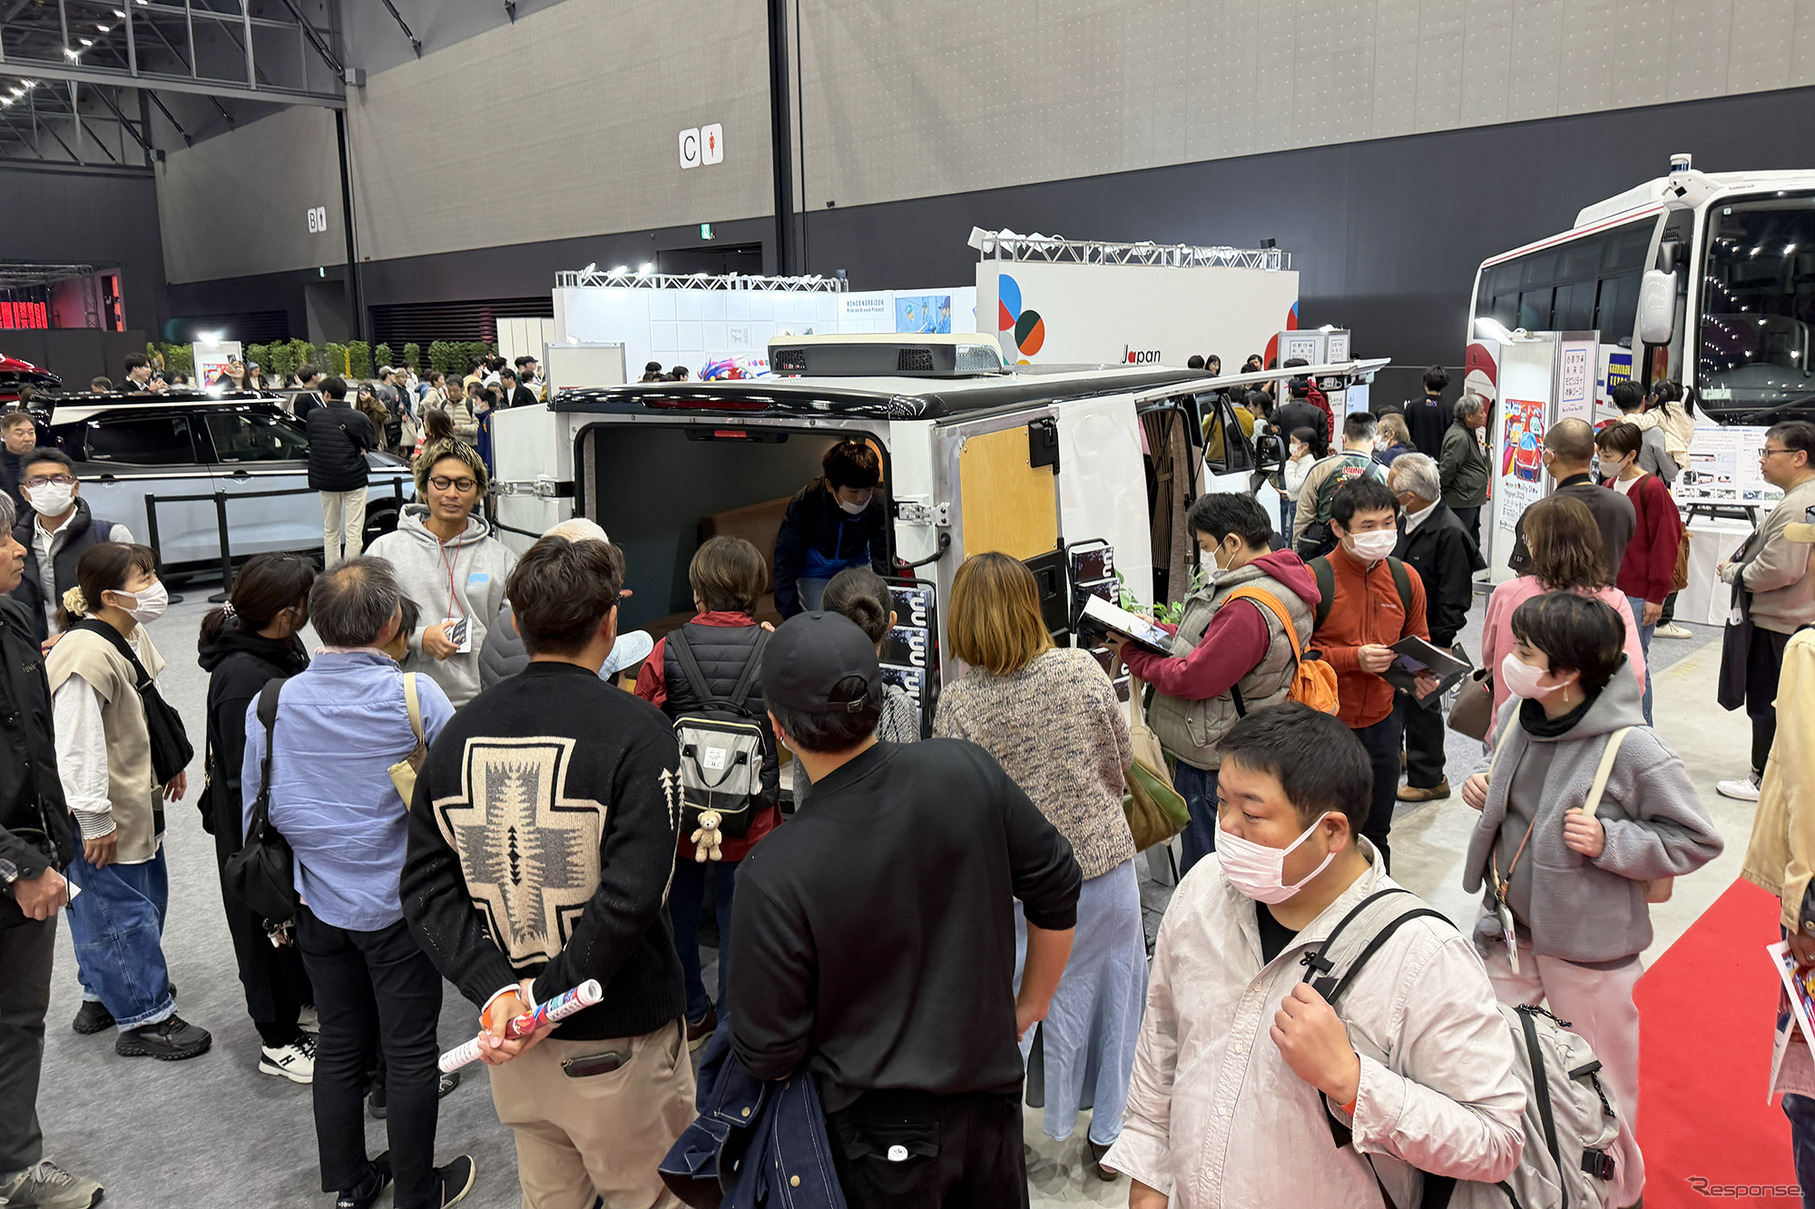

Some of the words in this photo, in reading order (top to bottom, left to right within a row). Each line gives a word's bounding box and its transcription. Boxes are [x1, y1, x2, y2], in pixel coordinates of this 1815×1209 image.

[683, 135, 696, 161] C
[310, 212, 316, 229] B
[1121, 344, 1161, 365] Japan
